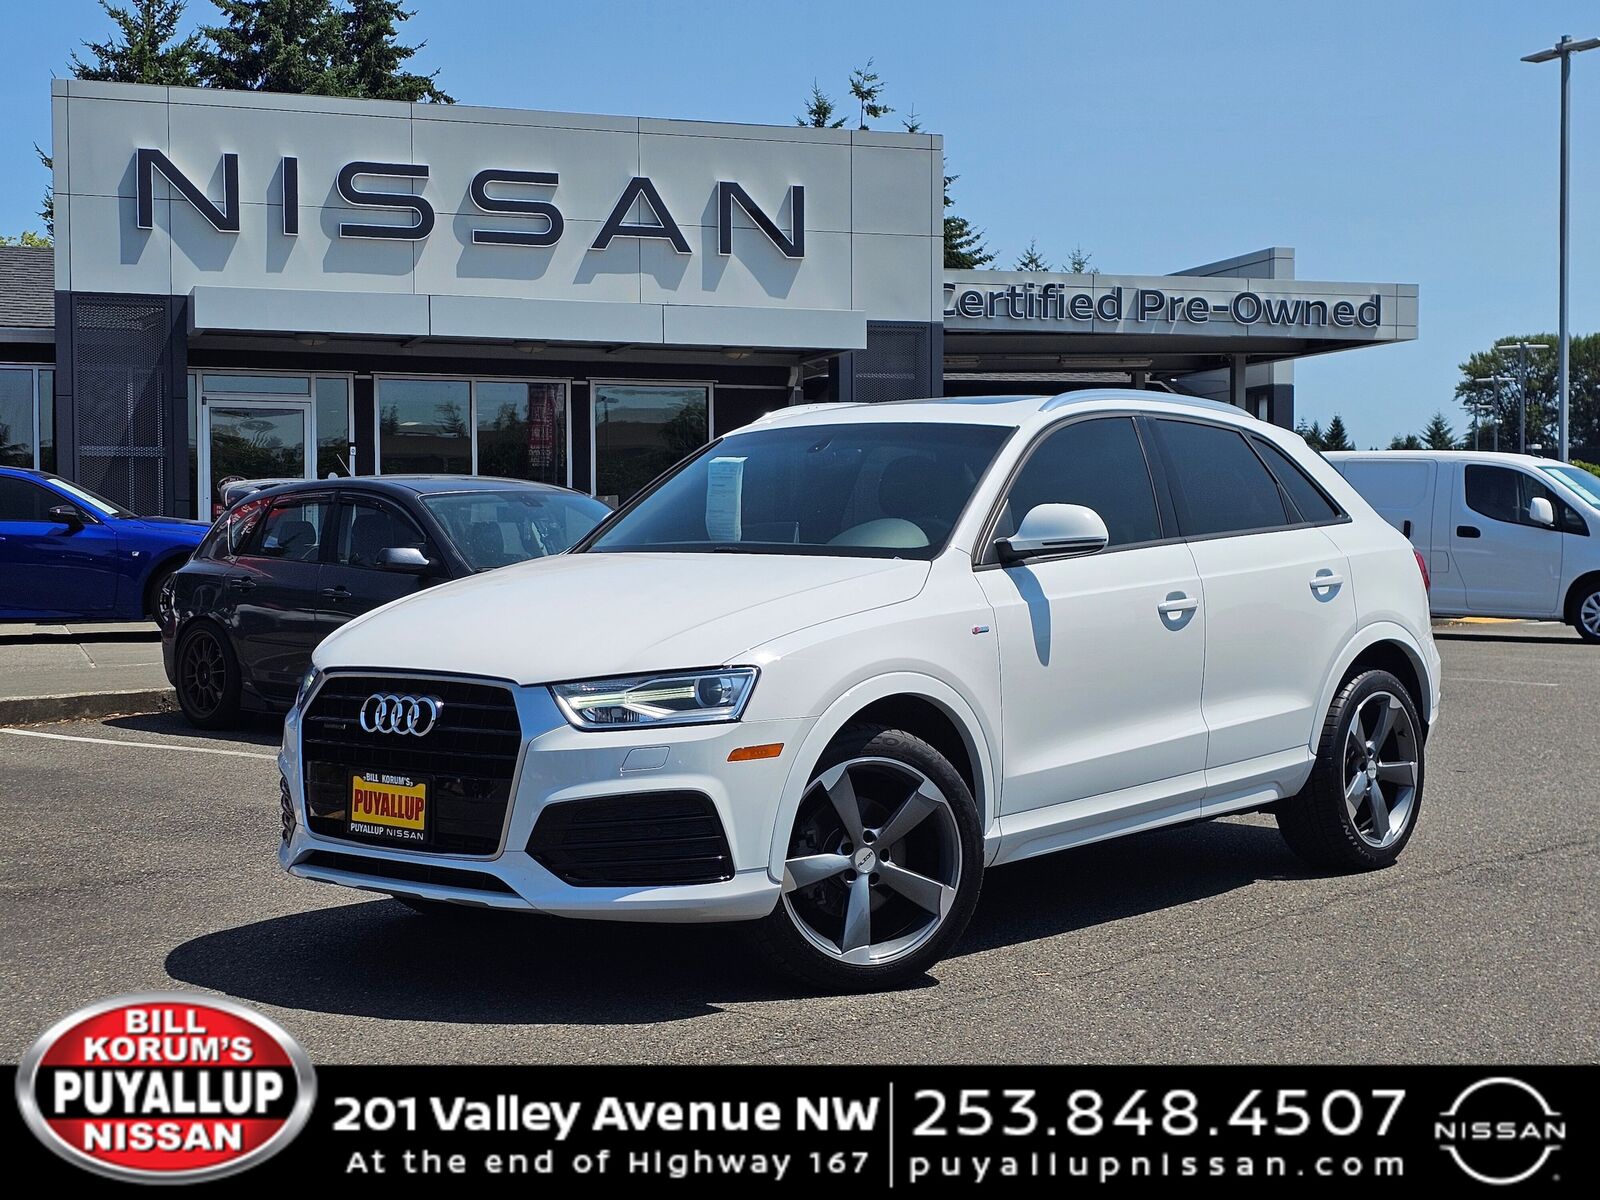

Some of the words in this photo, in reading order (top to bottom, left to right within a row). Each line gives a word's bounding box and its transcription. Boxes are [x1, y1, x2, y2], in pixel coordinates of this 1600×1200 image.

[135, 147, 806, 259] NISSAN
[1137, 288, 1382, 328] Pre-Owned
[365, 772, 379, 782] BILL
[381, 774, 411, 787] KORUM'S
[353, 788, 425, 821] PUYALLUP
[350, 822, 384, 836] PUYALLUP
[386, 828, 424, 841] NISSAN
